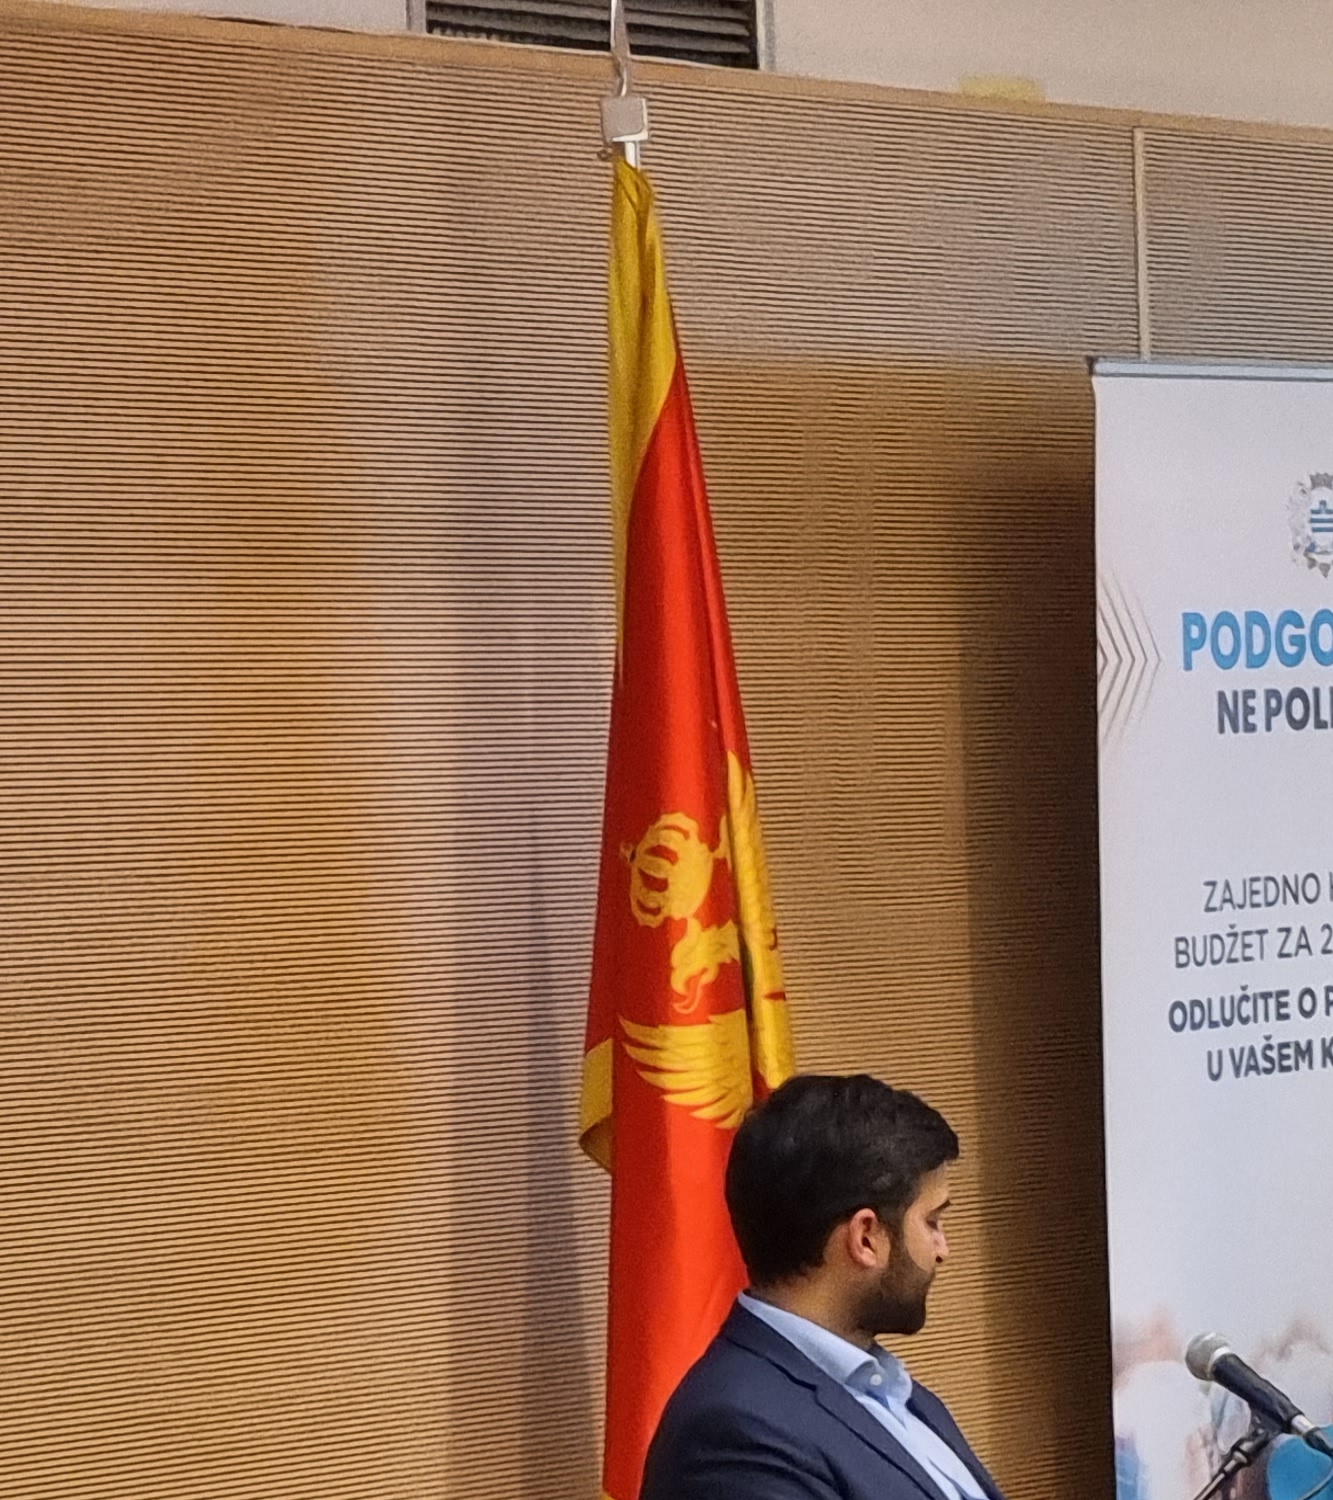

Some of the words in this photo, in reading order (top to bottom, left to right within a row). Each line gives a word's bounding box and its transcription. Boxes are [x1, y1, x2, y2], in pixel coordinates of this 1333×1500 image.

[1217, 689, 1257, 734] NE
[1203, 872, 1321, 912] ZAJEDNO
[1174, 924, 1268, 968] BUDŽET
[1277, 926, 1313, 958] ZA
[1168, 985, 1290, 1033] ODLUČITE
[1298, 987, 1318, 1019] O
[1207, 1050, 1224, 1081] U
[1229, 1034, 1314, 1078] VAŠEM
